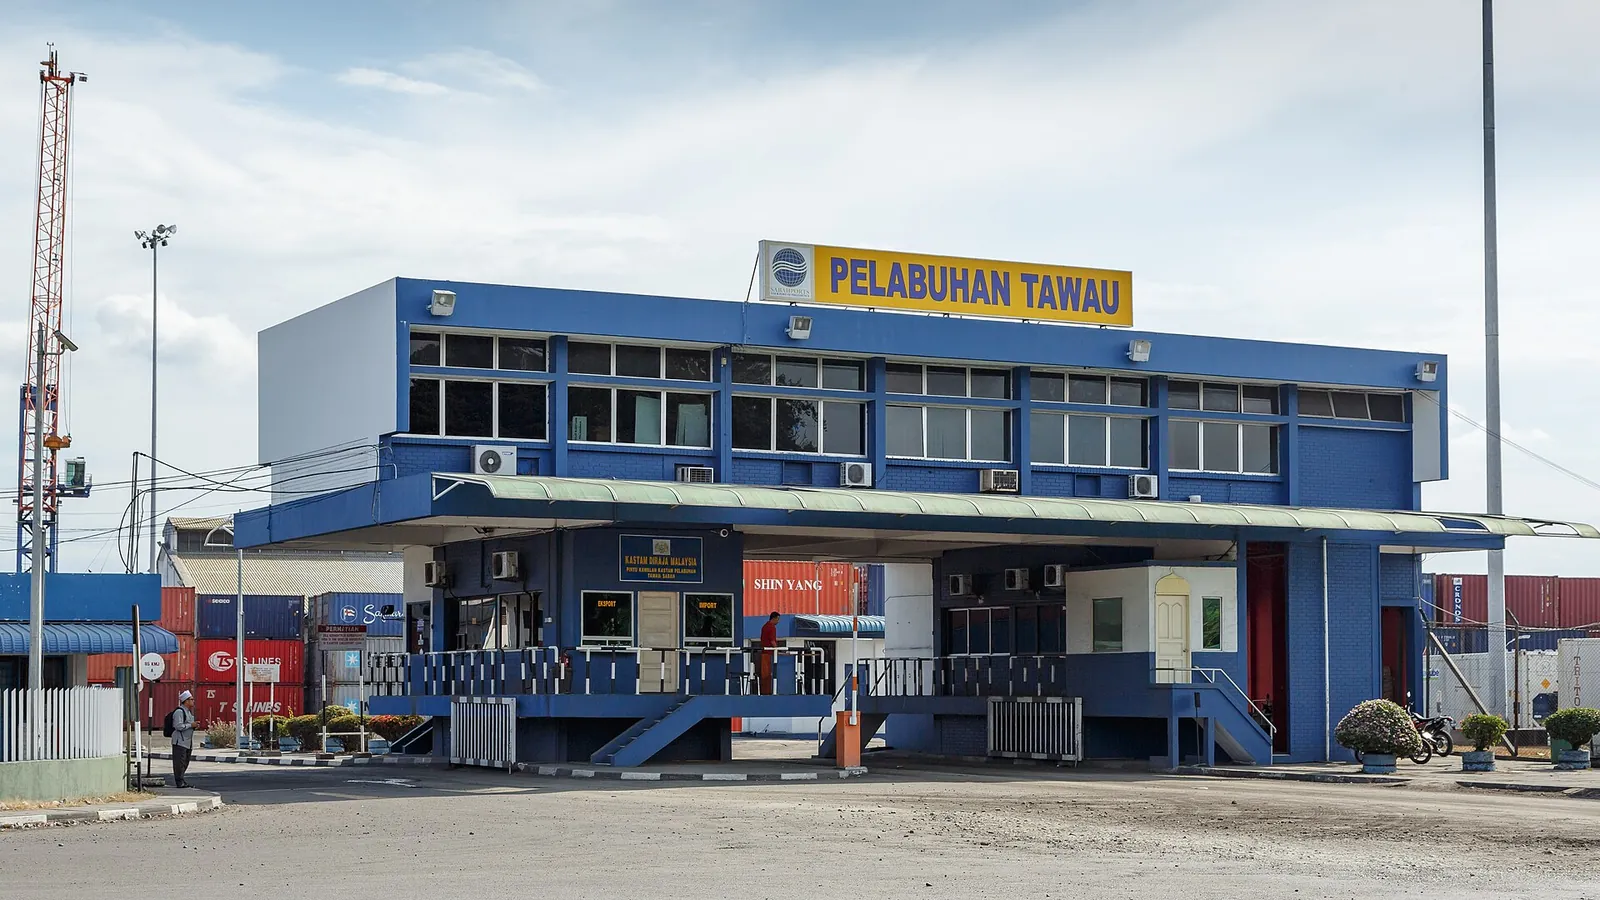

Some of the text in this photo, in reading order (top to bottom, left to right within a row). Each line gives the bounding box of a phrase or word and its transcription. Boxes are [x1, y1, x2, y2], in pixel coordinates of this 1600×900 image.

[830, 256, 1119, 315] PELABUHAN TAWAU
[624, 555, 697, 567] KASTAM DIRAJA MALAYSIA
[754, 578, 823, 591] SHIN YANG
[1454, 585, 1462, 622] CRONOS
[252, 656, 282, 668] LINES
[1573, 656, 1581, 707] TRITO
